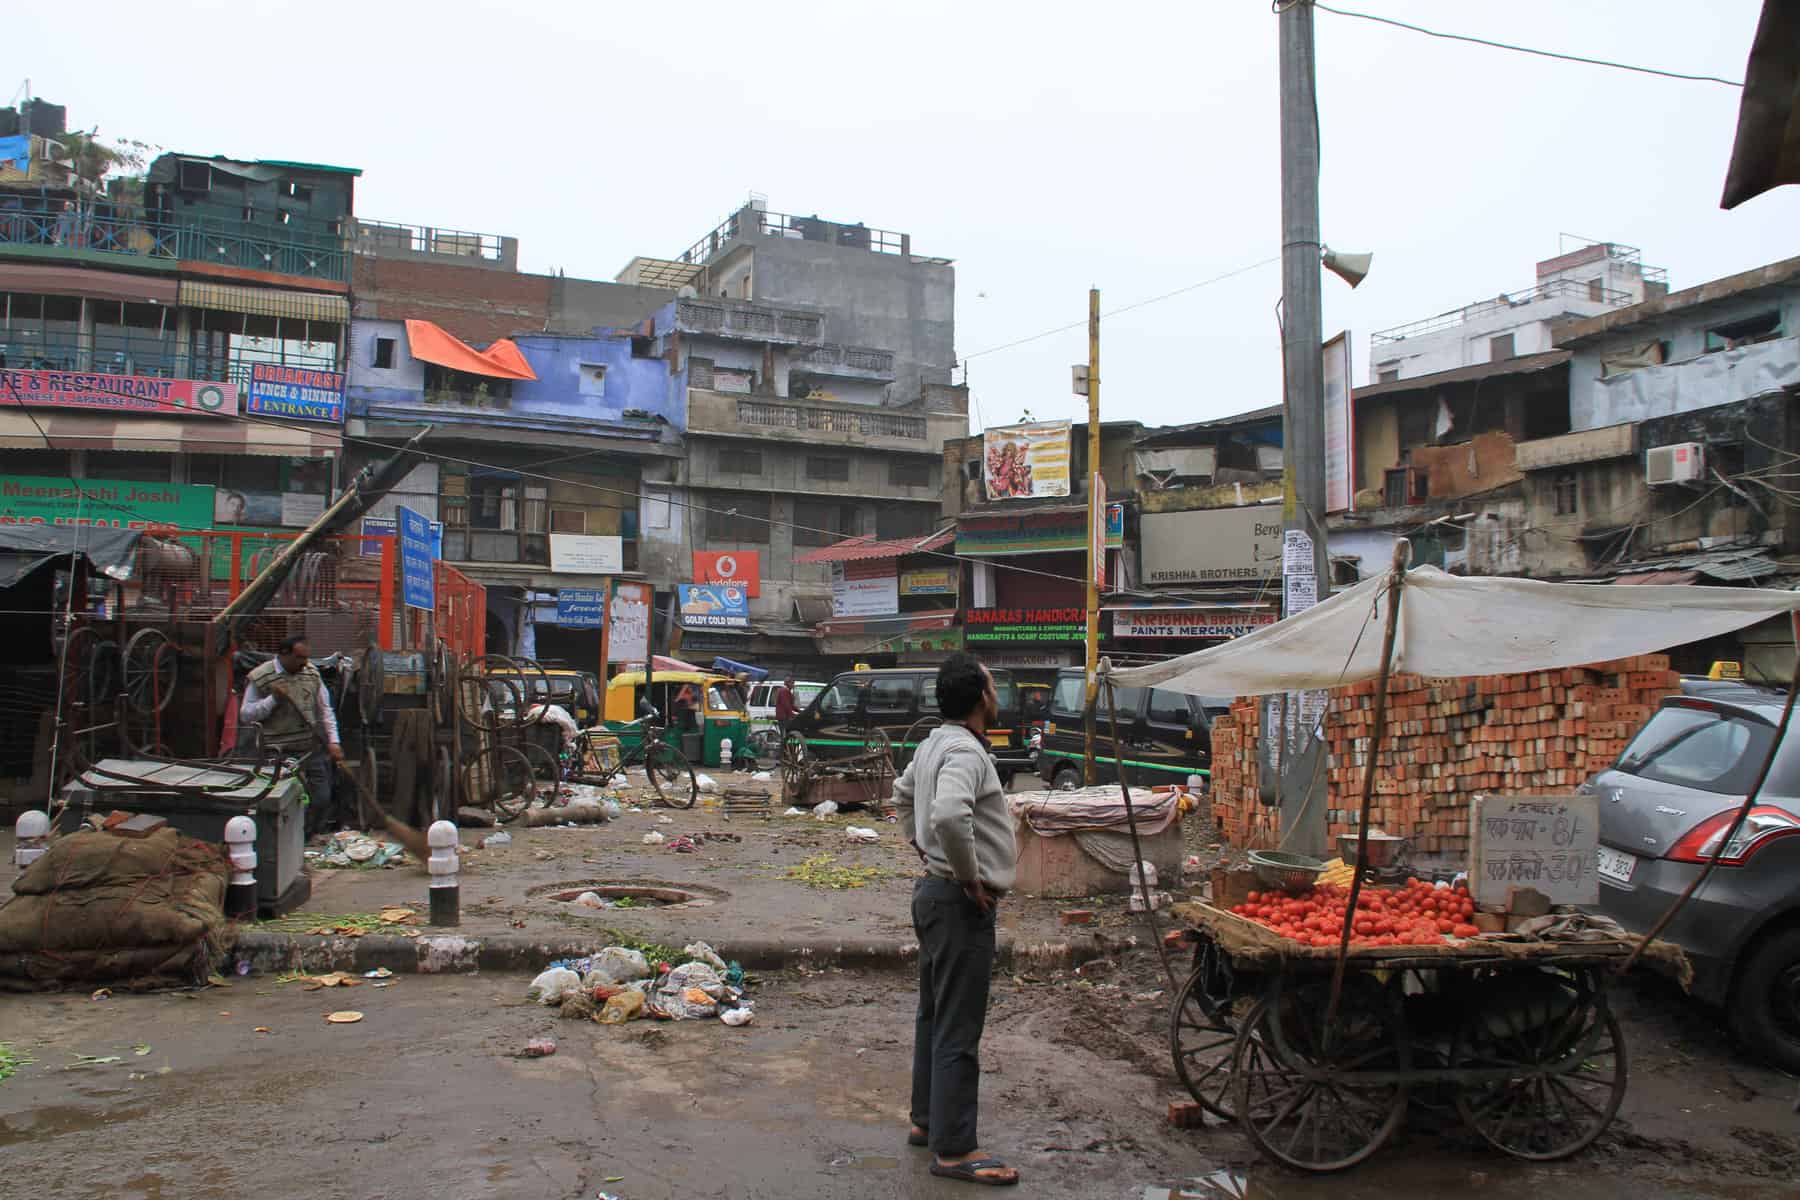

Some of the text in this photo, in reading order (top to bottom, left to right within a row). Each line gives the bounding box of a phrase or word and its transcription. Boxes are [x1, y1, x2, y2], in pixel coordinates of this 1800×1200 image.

[29, 375, 41, 390] &
[50, 374, 172, 398] RESTAURANT
[253, 381, 341, 404] LUNCH & DINNER
[264, 400, 329, 418] ENTRANCE
[125, 487, 180, 504] Joshi
[1254, 523, 1282, 539] Berg
[1151, 568, 1197, 581] KRISHNA
[1200, 567, 1258, 579] BROTHERS
[684, 615, 708, 625] GOLDY
[708, 615, 726, 625] COLD
[967, 609, 1023, 624] BANARAS
[1132, 613, 1207, 625] KRISHNA
[1210, 614, 1274, 625] BROTHERS
[1131, 626, 1175, 635] PAINTS
